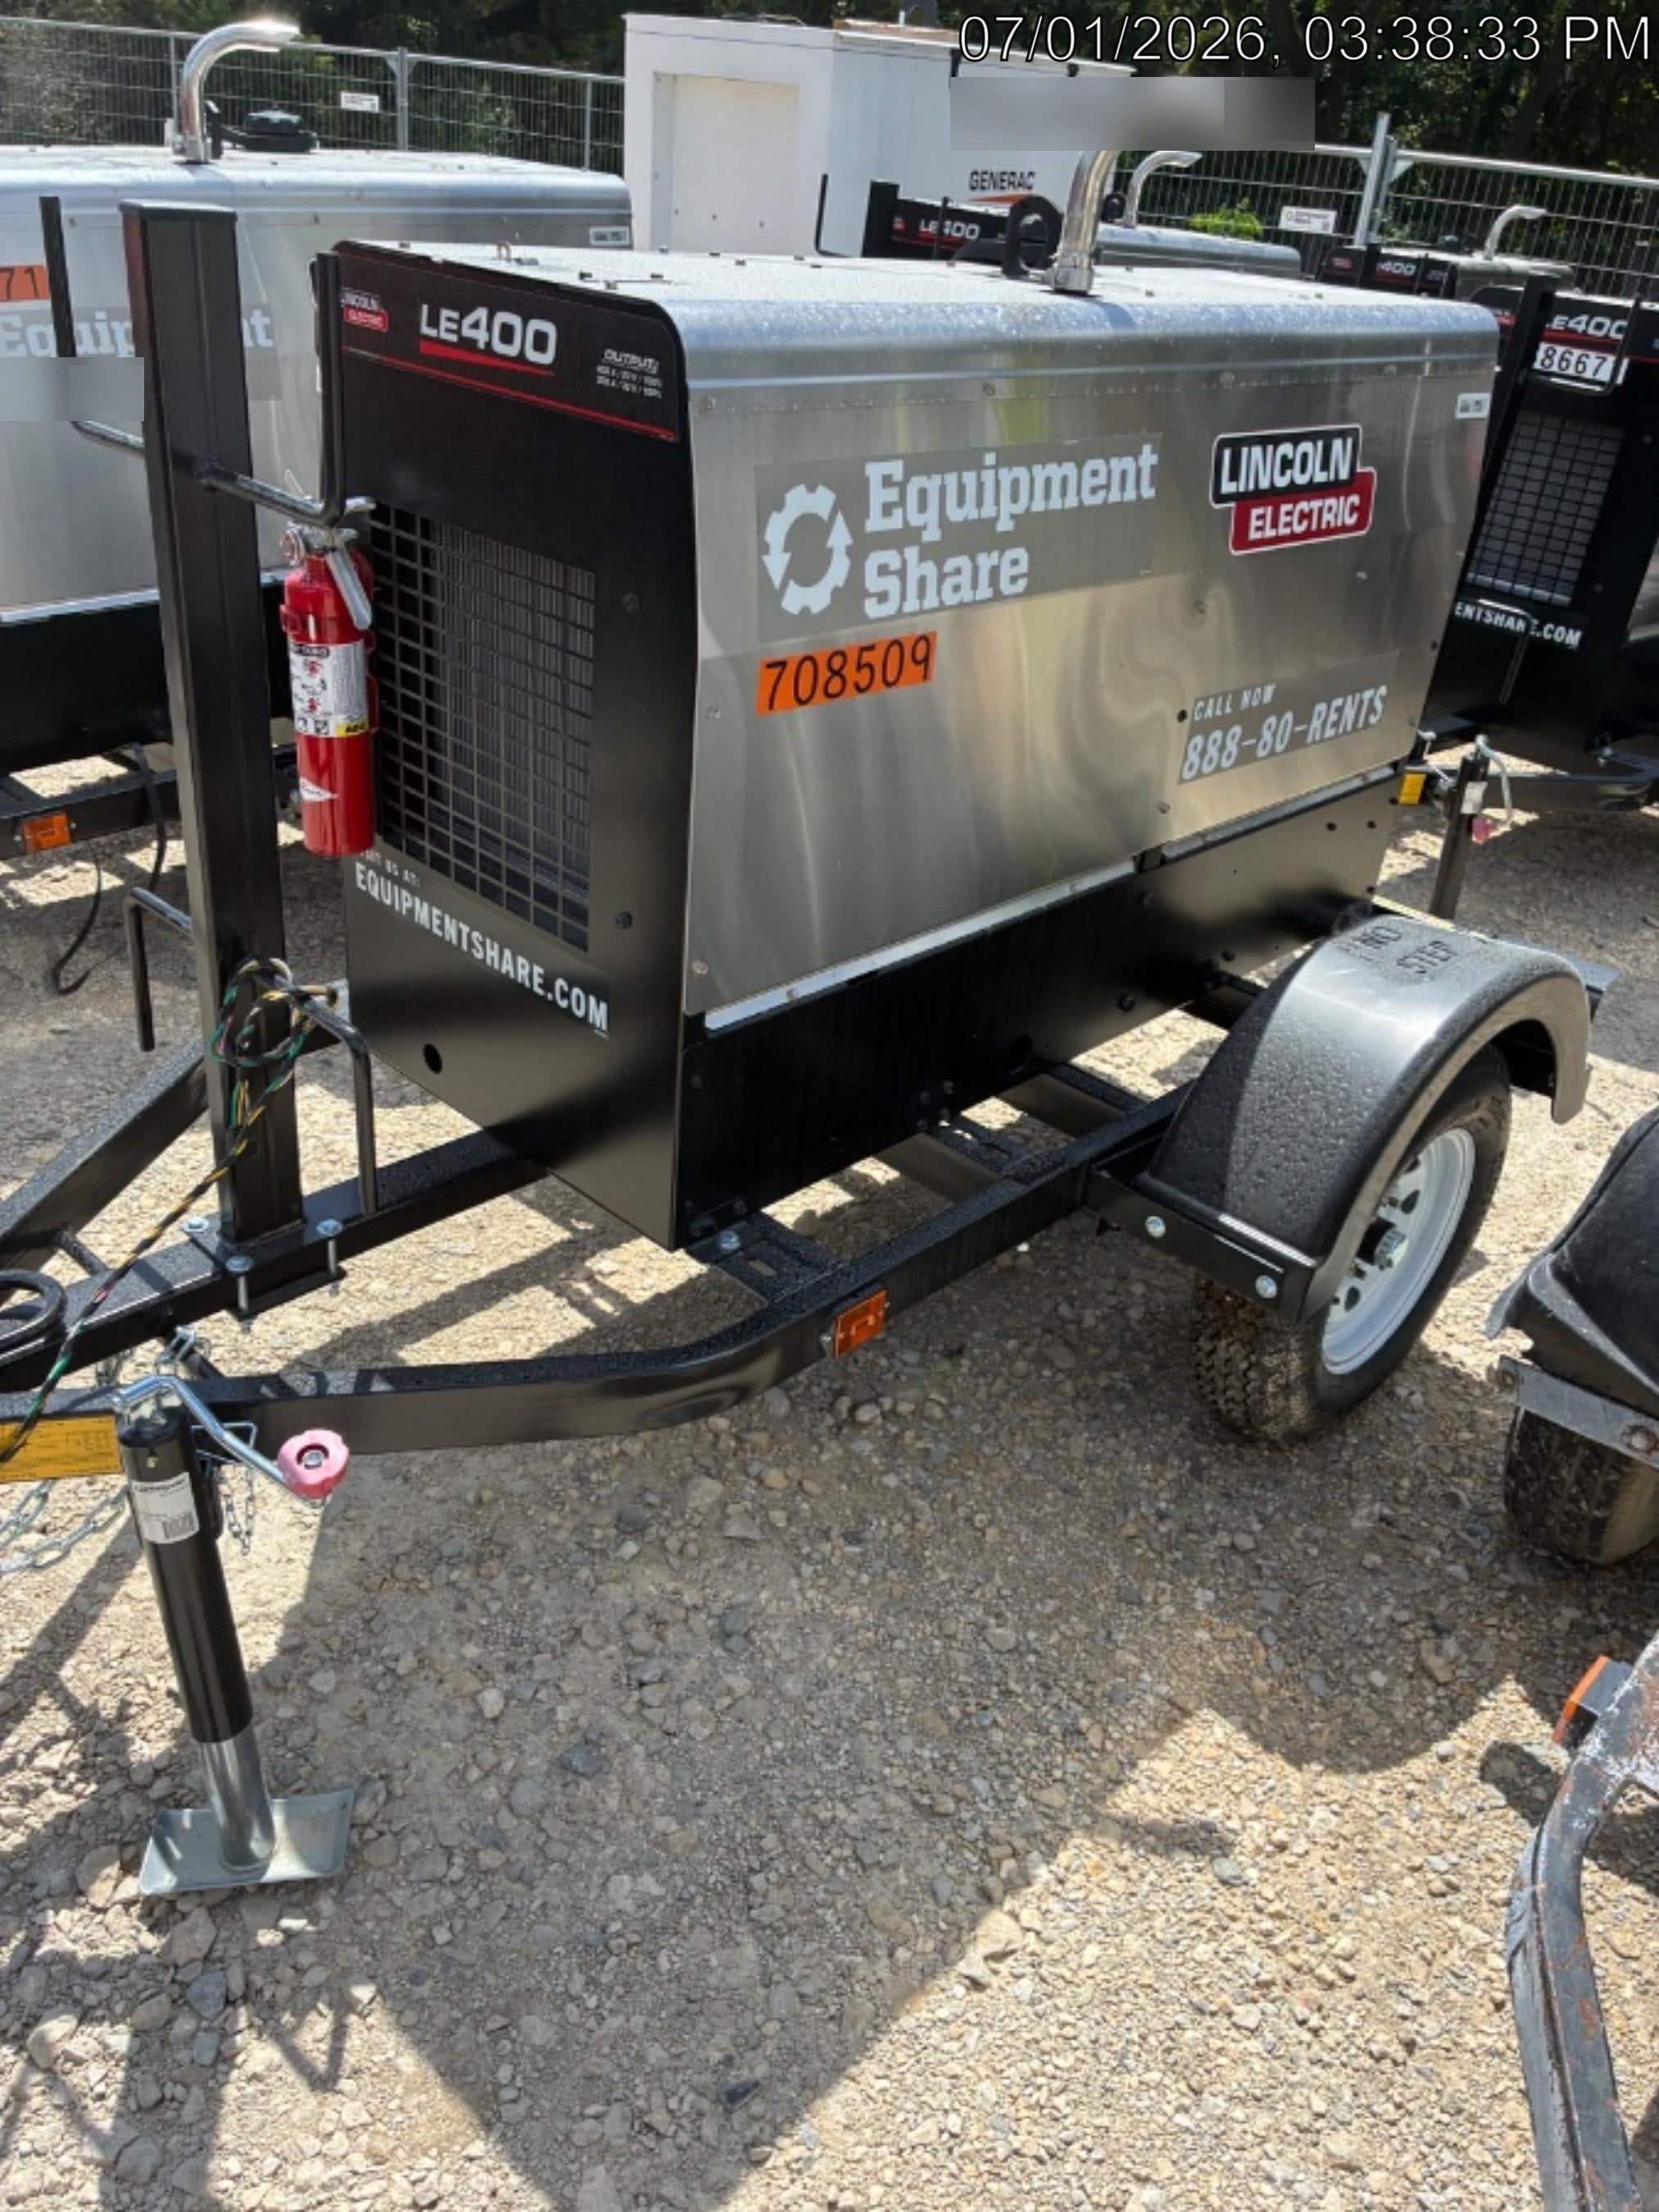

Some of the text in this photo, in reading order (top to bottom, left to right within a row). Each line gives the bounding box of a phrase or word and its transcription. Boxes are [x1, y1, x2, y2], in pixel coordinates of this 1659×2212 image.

[968, 170, 1036, 191] GENERAC
[419, 304, 558, 365] LE400
[864, 445, 1158, 542] Equipment
[1222, 437, 1353, 495] LINCOLN
[1249, 495, 1360, 541] ELECTRIC
[864, 546, 1029, 619] Share
[765, 637, 931, 709] 708509
[1194, 682, 1276, 722] CALL NOW
[1181, 685, 1388, 781] 888-80-RENTS
[355, 861, 608, 1031] EQUIPMENTSHARE.COM
